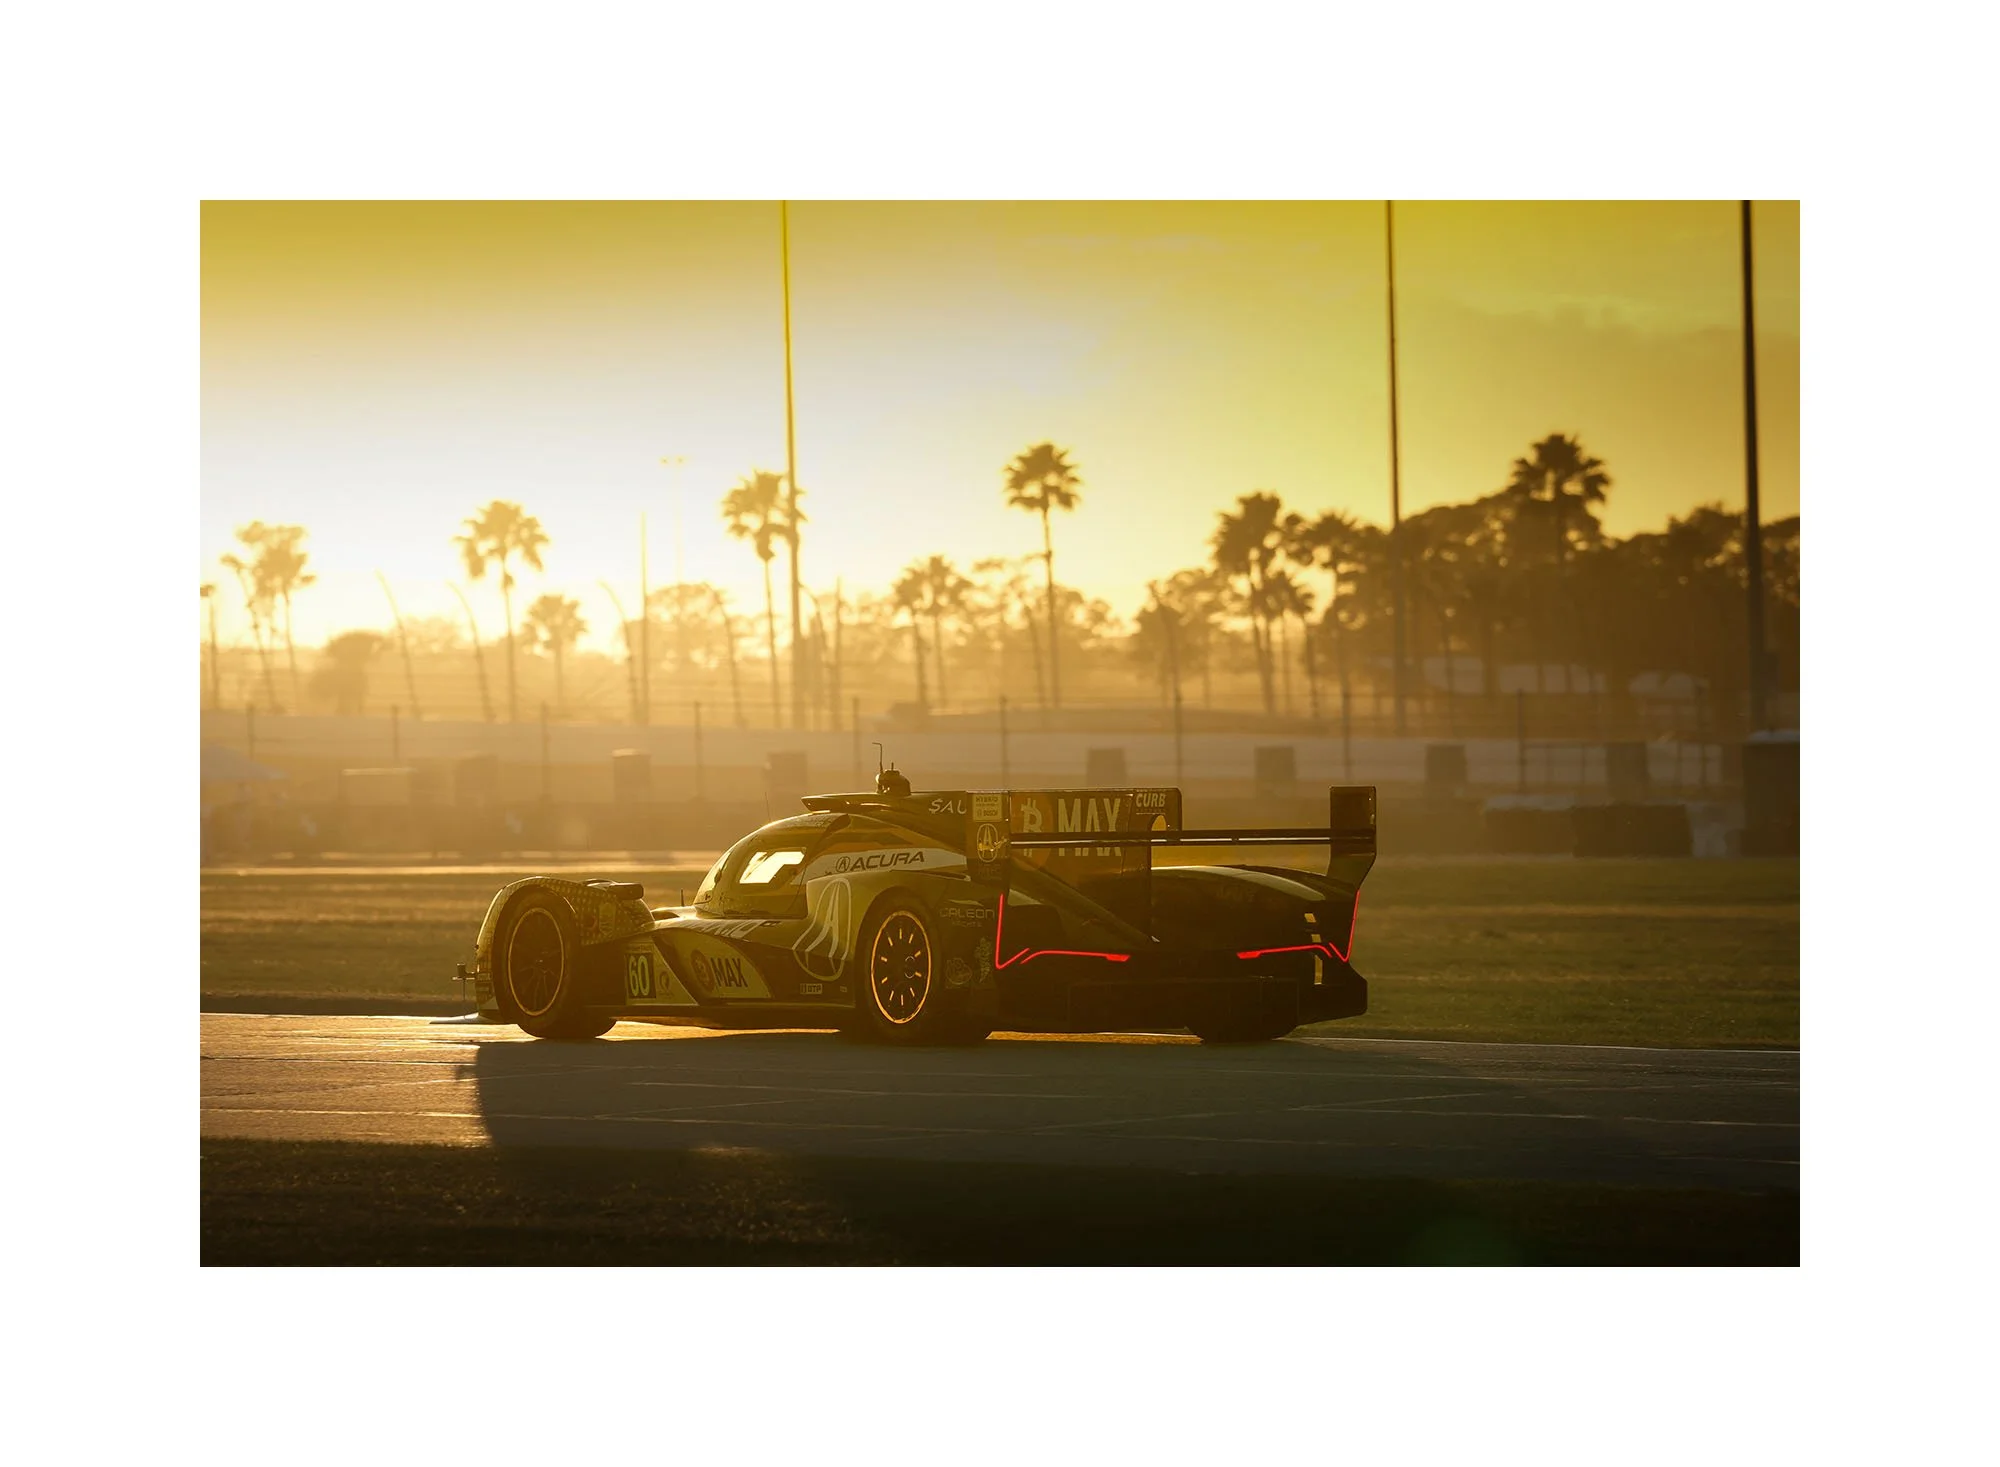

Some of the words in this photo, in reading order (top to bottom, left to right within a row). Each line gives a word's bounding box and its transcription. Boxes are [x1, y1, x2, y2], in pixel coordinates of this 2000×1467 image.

[1136, 792, 1166, 808] CURB
[1058, 797, 1122, 857] MAX
[850, 851, 925, 871] ACURA
[628, 955, 650, 997] 60
[710, 957, 748, 988] MAX
